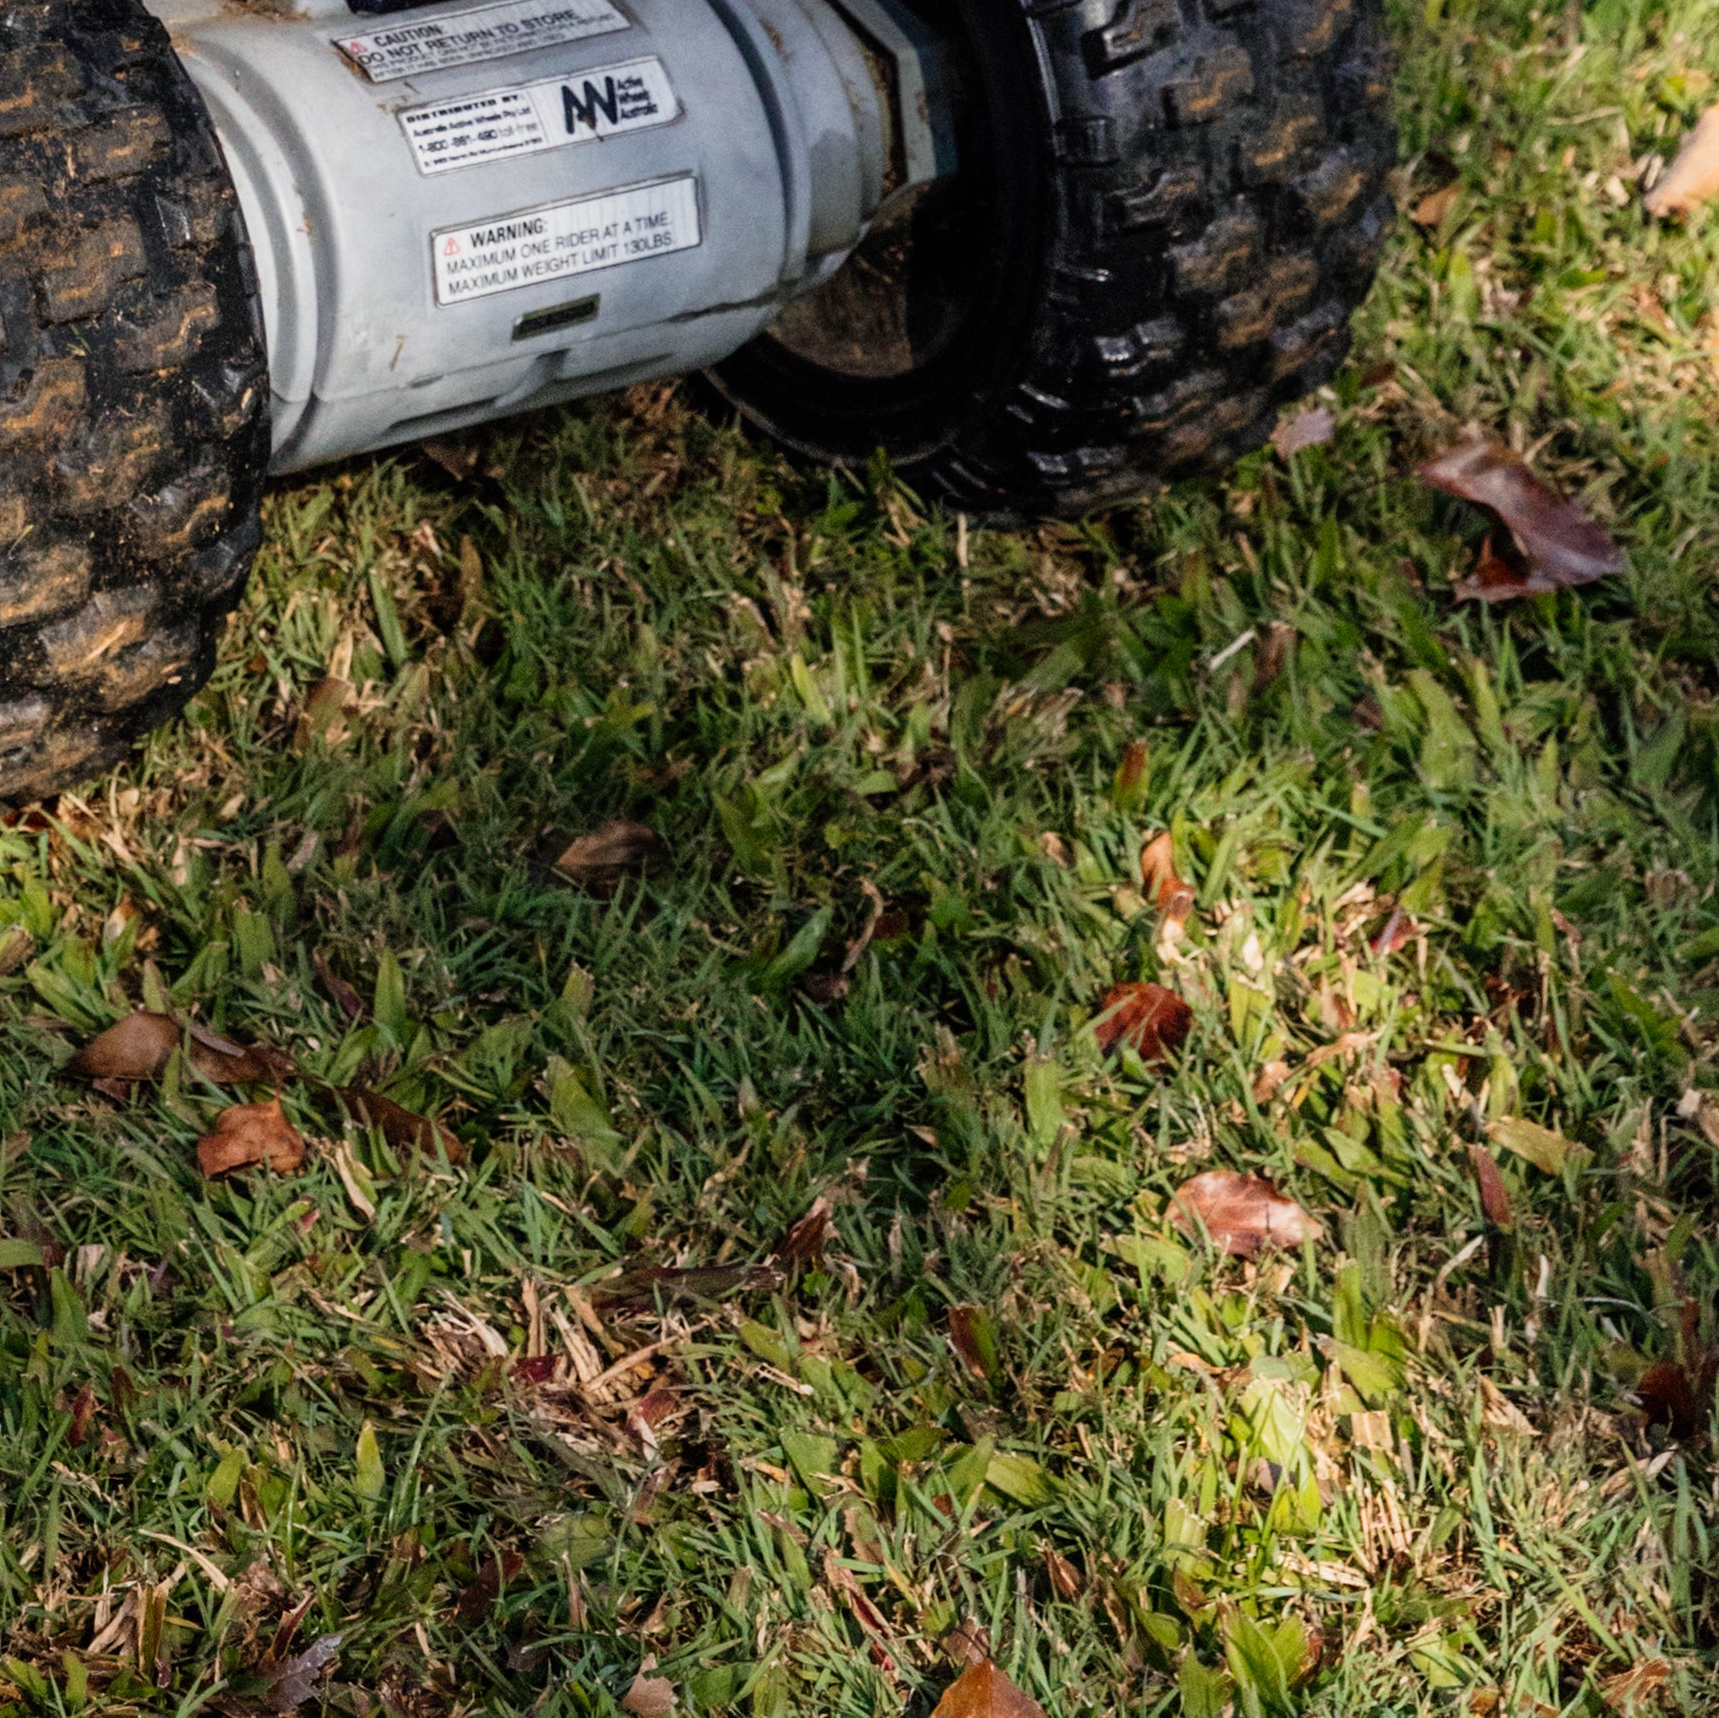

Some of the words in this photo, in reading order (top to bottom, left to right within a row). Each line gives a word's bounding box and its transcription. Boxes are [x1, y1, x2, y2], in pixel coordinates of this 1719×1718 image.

[358, 49, 377, 64] DO
[388, 42, 423, 59] NOT
[426, 28, 496, 52] RETURN
[497, 22, 520, 38] TO
[522, 10, 580, 31] STORE
[617, 77, 643, 91] Active
[445, 247, 516, 274] MAXIMUM
[521, 240, 551, 259] ONE
[555, 227, 600, 250] RIDER
[602, 223, 619, 238] AT
[623, 221, 632, 233] A
[470, 218, 548, 248] WARNING:
[448, 267, 518, 296] MAXIMUM
[521, 253, 579, 278] WEIGHT
[582, 244, 618, 265] LIMIT
